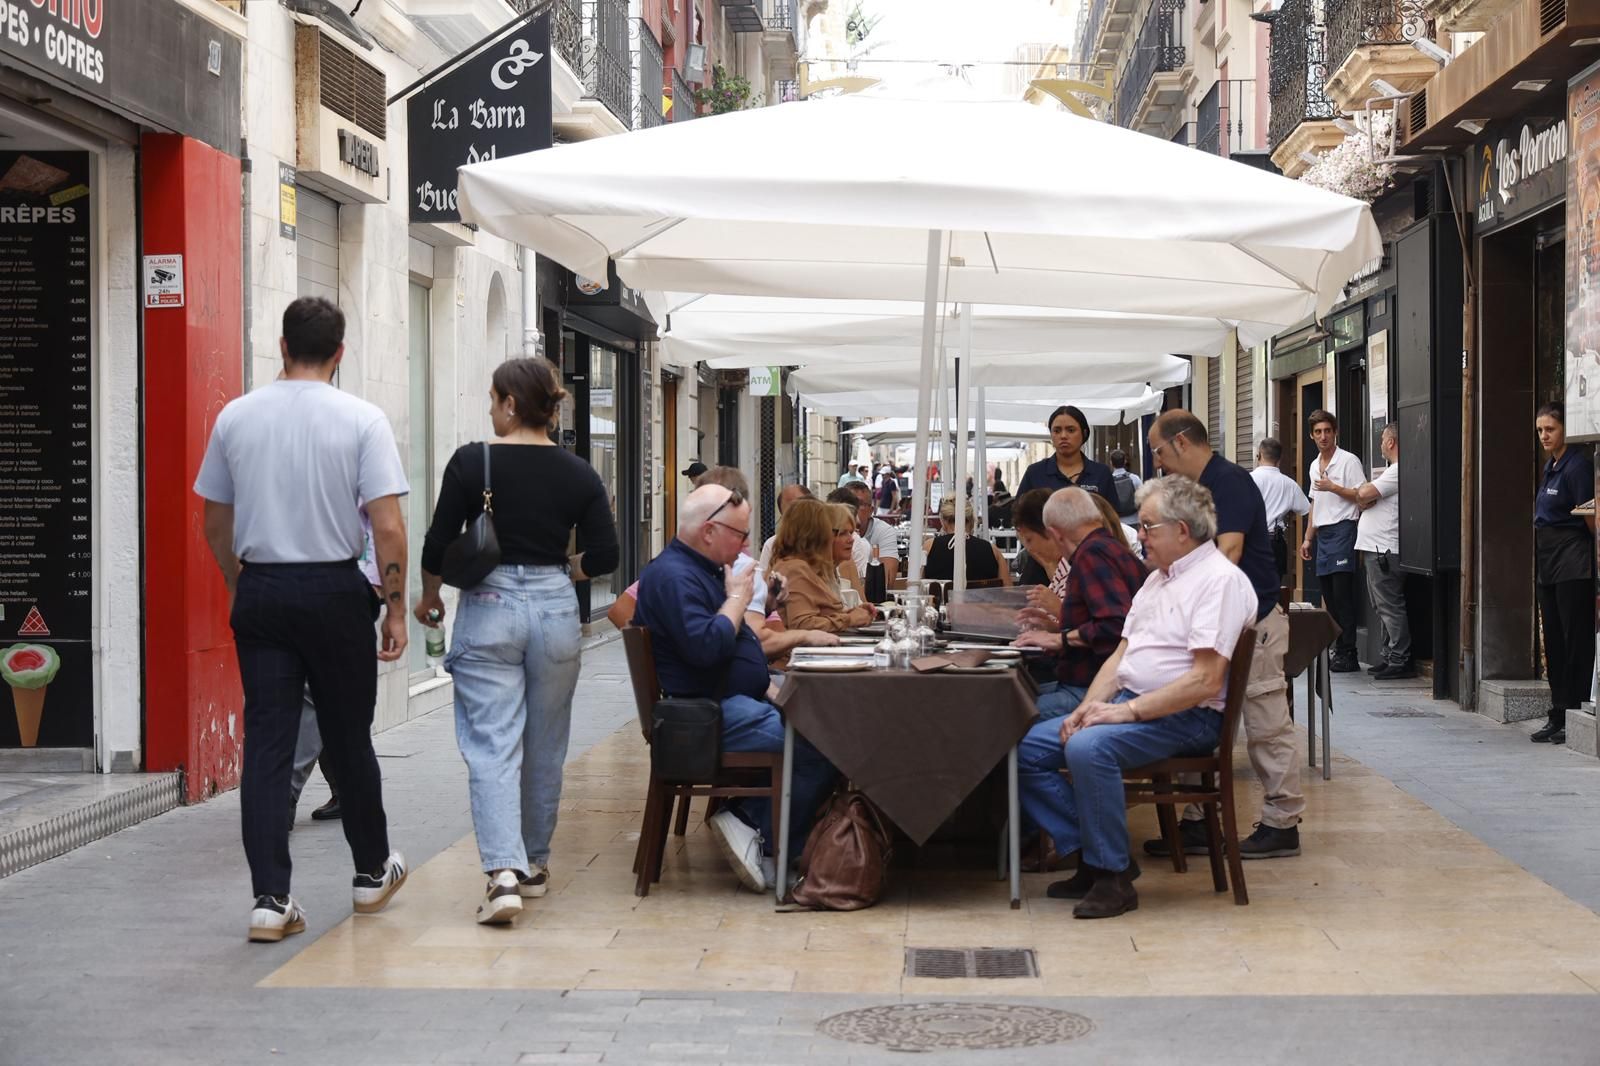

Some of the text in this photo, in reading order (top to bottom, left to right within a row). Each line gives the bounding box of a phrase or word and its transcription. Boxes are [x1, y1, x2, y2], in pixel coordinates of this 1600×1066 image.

[45, 24, 104, 84] GOFRES
[431, 98, 526, 130] La Barra
[1495, 138, 1519, 205] Los
[0, 203, 77, 224] RÊPES
[751, 376, 771, 385] ATM
